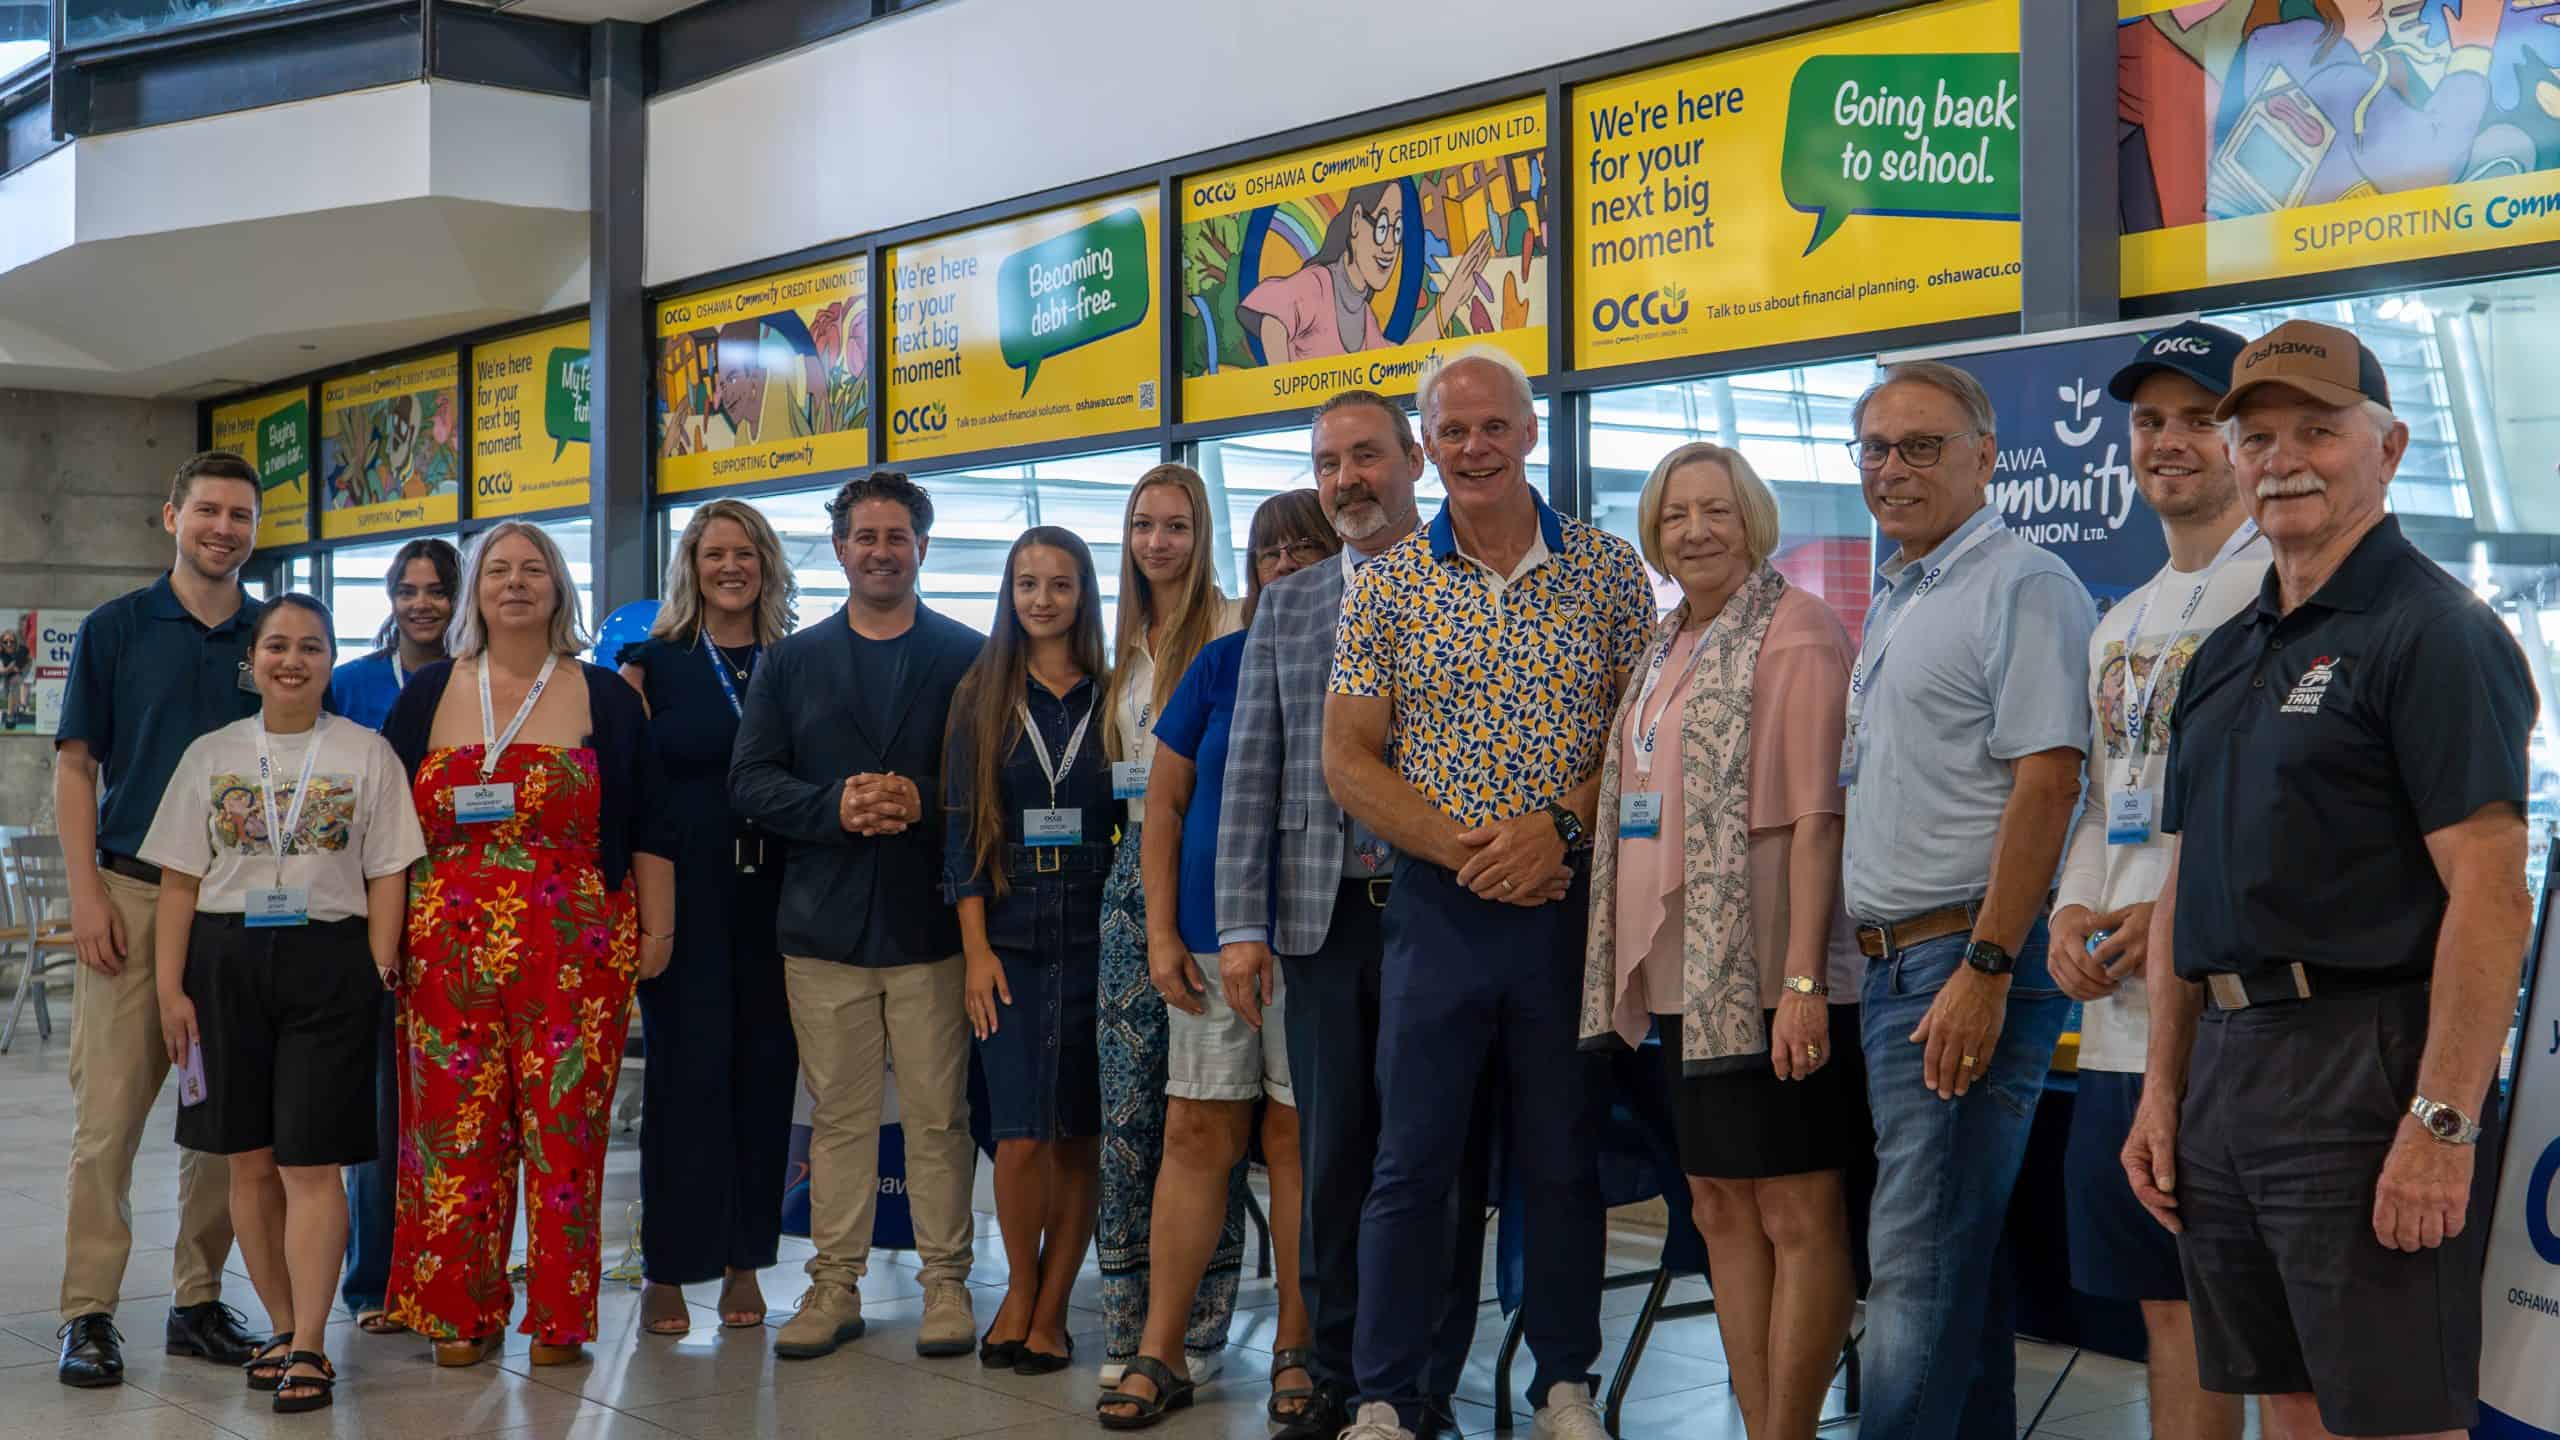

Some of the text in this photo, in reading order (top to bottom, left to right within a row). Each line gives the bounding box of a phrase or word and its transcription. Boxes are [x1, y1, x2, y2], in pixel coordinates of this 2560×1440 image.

[1590, 86, 1744, 143] We're here
[1833, 78, 2017, 140] Going back
[1193, 181, 1236, 206] OCCU
[1245, 168, 1306, 196] OSHAWA
[1388, 136, 1442, 163] CREDIT
[1446, 124, 1500, 151] UNION
[1506, 114, 1541, 139] LTD.
[1590, 137, 1705, 185] for your
[1841, 136, 1995, 184] to school.
[1590, 175, 1710, 226] next big
[1591, 218, 1715, 267] moment
[2294, 204, 2473, 252] SUPPORTING
[892, 255, 977, 292] We're here
[1028, 247, 1113, 298] Becoming
[696, 298, 733, 319] OSHAWA
[781, 280, 812, 299] CREDIT
[815, 271, 850, 292] UNION
[892, 291, 956, 324] for your
[1031, 286, 1117, 336] debt-free.
[1592, 282, 1688, 332] OCCU
[1706, 305, 1731, 320] Talk
[1733, 304, 1746, 317] to
[1748, 301, 1762, 314] us
[1764, 293, 1801, 312] about
[1801, 285, 1855, 307] financial
[1857, 277, 1920, 303] planning.
[892, 320, 959, 354] next big
[2154, 335, 2212, 356] OCCU
[2246, 340, 2327, 368] Oshawa
[478, 360, 506, 382] We're
[509, 353, 532, 375] here
[562, 362, 580, 399] My
[892, 353, 962, 386] moment
[1273, 367, 1363, 396] SUPPORTING
[478, 384, 519, 408] for your
[956, 416, 971, 430] Talk
[972, 416, 978, 427] to
[979, 416, 987, 427] us
[987, 411, 1008, 425] about
[1008, 407, 1037, 423] financial
[1075, 393, 1134, 413] oshawacu.com
[478, 407, 520, 431] next big
[893, 400, 947, 435] OCCU
[478, 431, 522, 456] moment
[712, 455, 767, 476] SUPPORTING
[1984, 443, 2136, 529] munity
[2084, 527, 2108, 541] LTD.
[2287, 693, 2324, 705] TANK
[2507, 1287, 2560, 1318] OSHAWA
